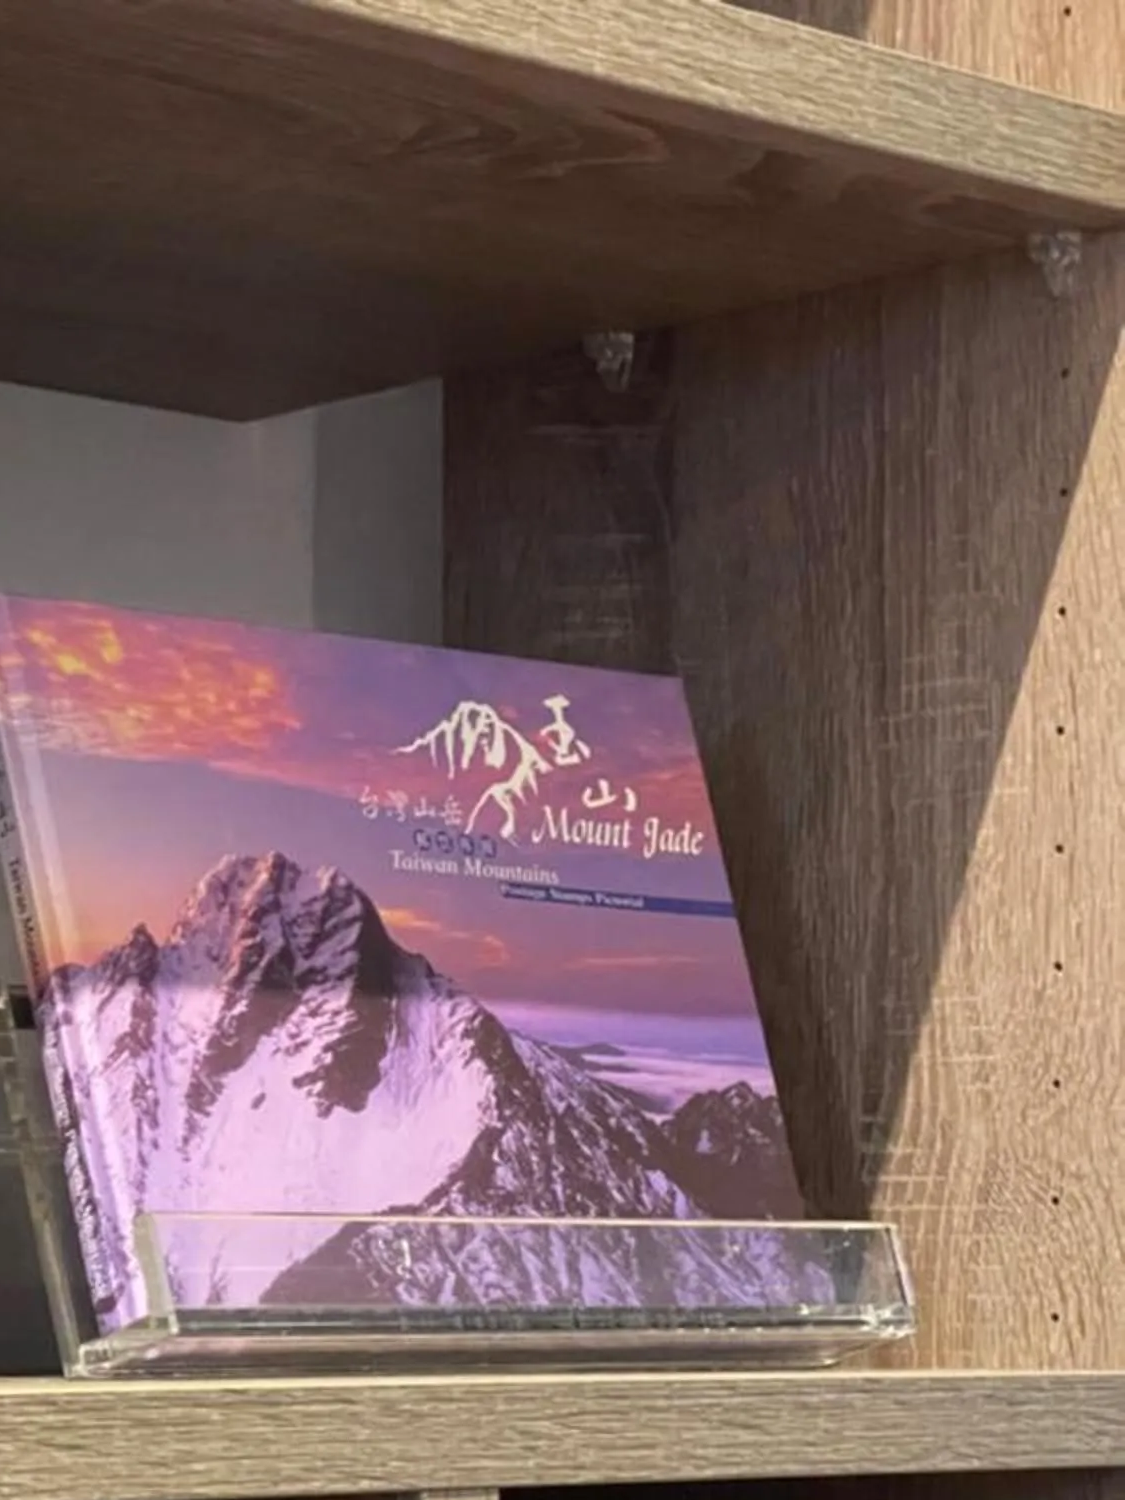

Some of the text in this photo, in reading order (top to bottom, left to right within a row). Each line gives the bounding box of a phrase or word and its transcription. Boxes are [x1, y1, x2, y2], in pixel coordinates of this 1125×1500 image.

[531, 805, 632, 849] Mount
[642, 816, 705, 859] Jade
[389, 849, 560, 886] Taiwan Mountains
